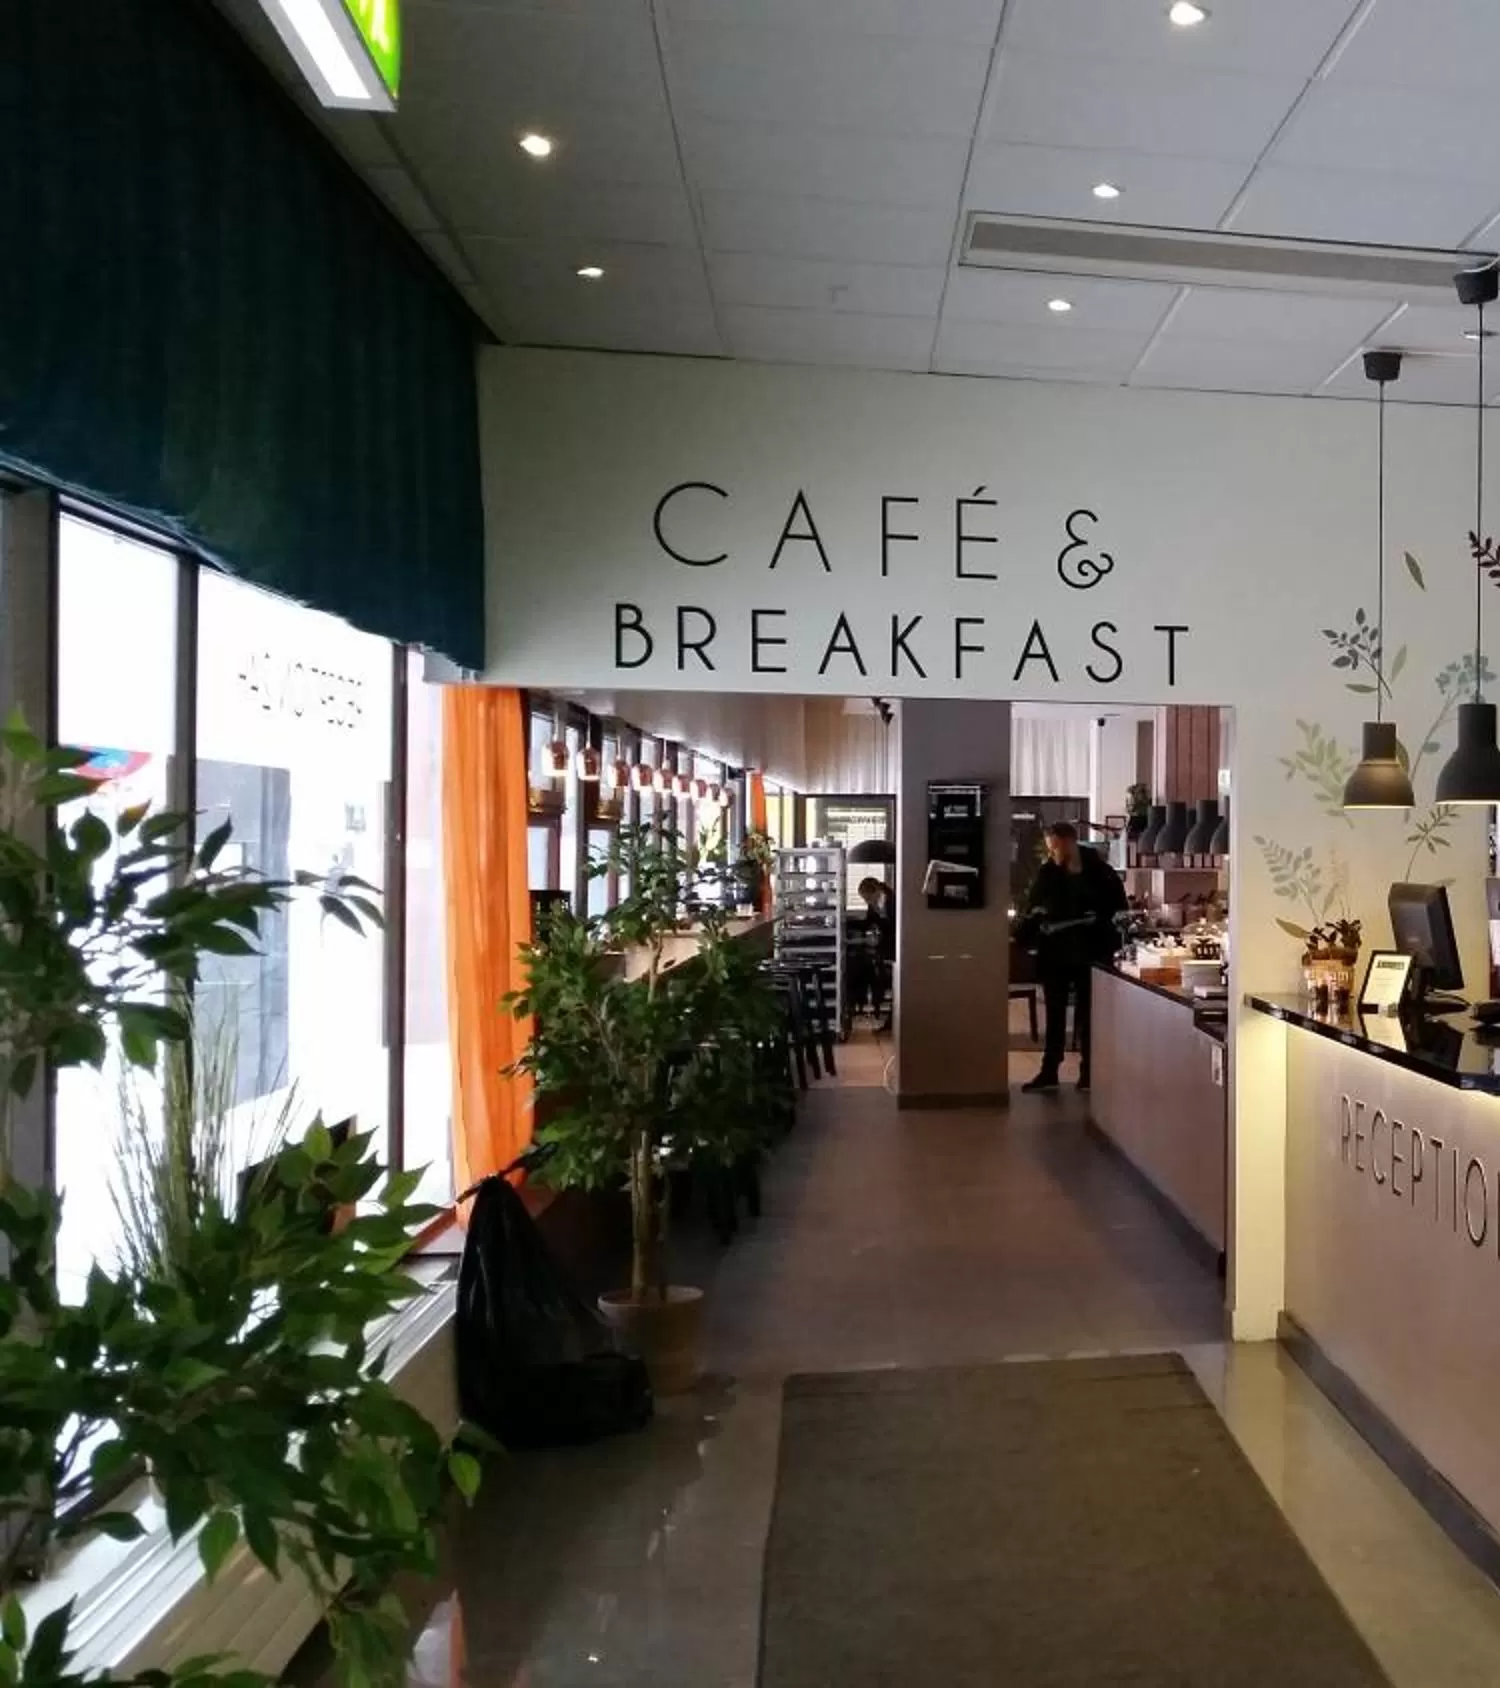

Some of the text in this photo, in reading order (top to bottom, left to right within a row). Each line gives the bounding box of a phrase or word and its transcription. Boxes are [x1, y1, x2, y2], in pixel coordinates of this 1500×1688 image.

[653, 481, 1114, 589] CAFÉ &
[614, 602, 1189, 687] BREAKFAST
